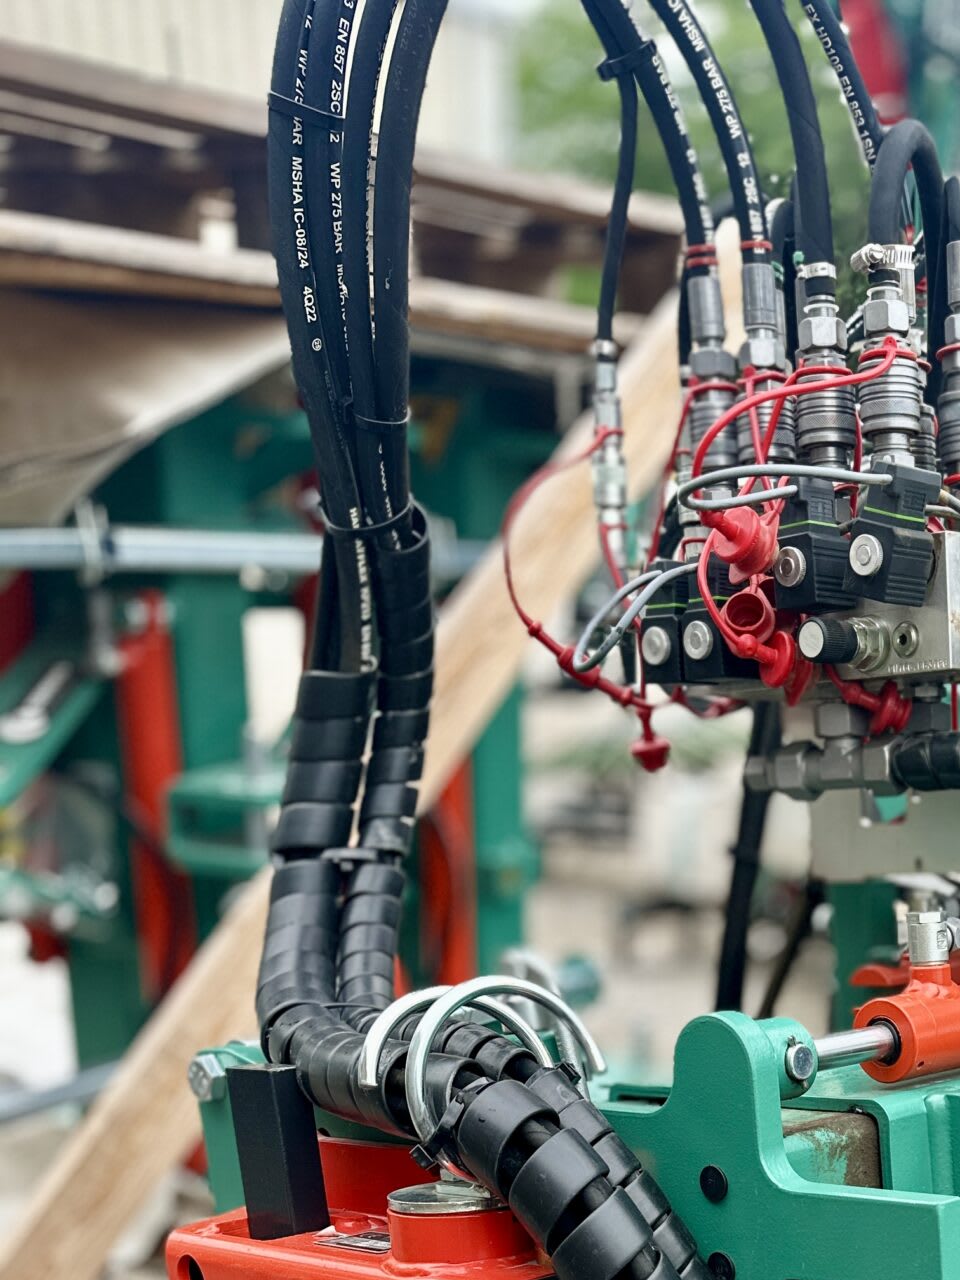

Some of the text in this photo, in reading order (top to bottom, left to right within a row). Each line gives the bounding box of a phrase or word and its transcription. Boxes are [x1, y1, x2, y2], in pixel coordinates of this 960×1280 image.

[337, 18, 350, 43] EN
[677, 14, 706, 53] MSHA
[333, 44, 346, 74] 857
[701, 56, 723, 90] BAR
[330, 79, 342, 113] 2SC
[716, 87, 734, 114] 275
[816, 26, 844, 74] HD108
[840, 75, 855, 98] EN
[849, 100, 865, 128] 853
[860, 130, 876, 160] 1SN
[291, 116, 303, 145] AR
[725, 114, 742, 140] WP
[291, 156, 303, 205] MSHA
[330, 162, 341, 189] WP
[331, 193, 342, 218] 275
[293, 207, 309, 269] IC-08/24
[302, 286, 318, 323] 4Q22
